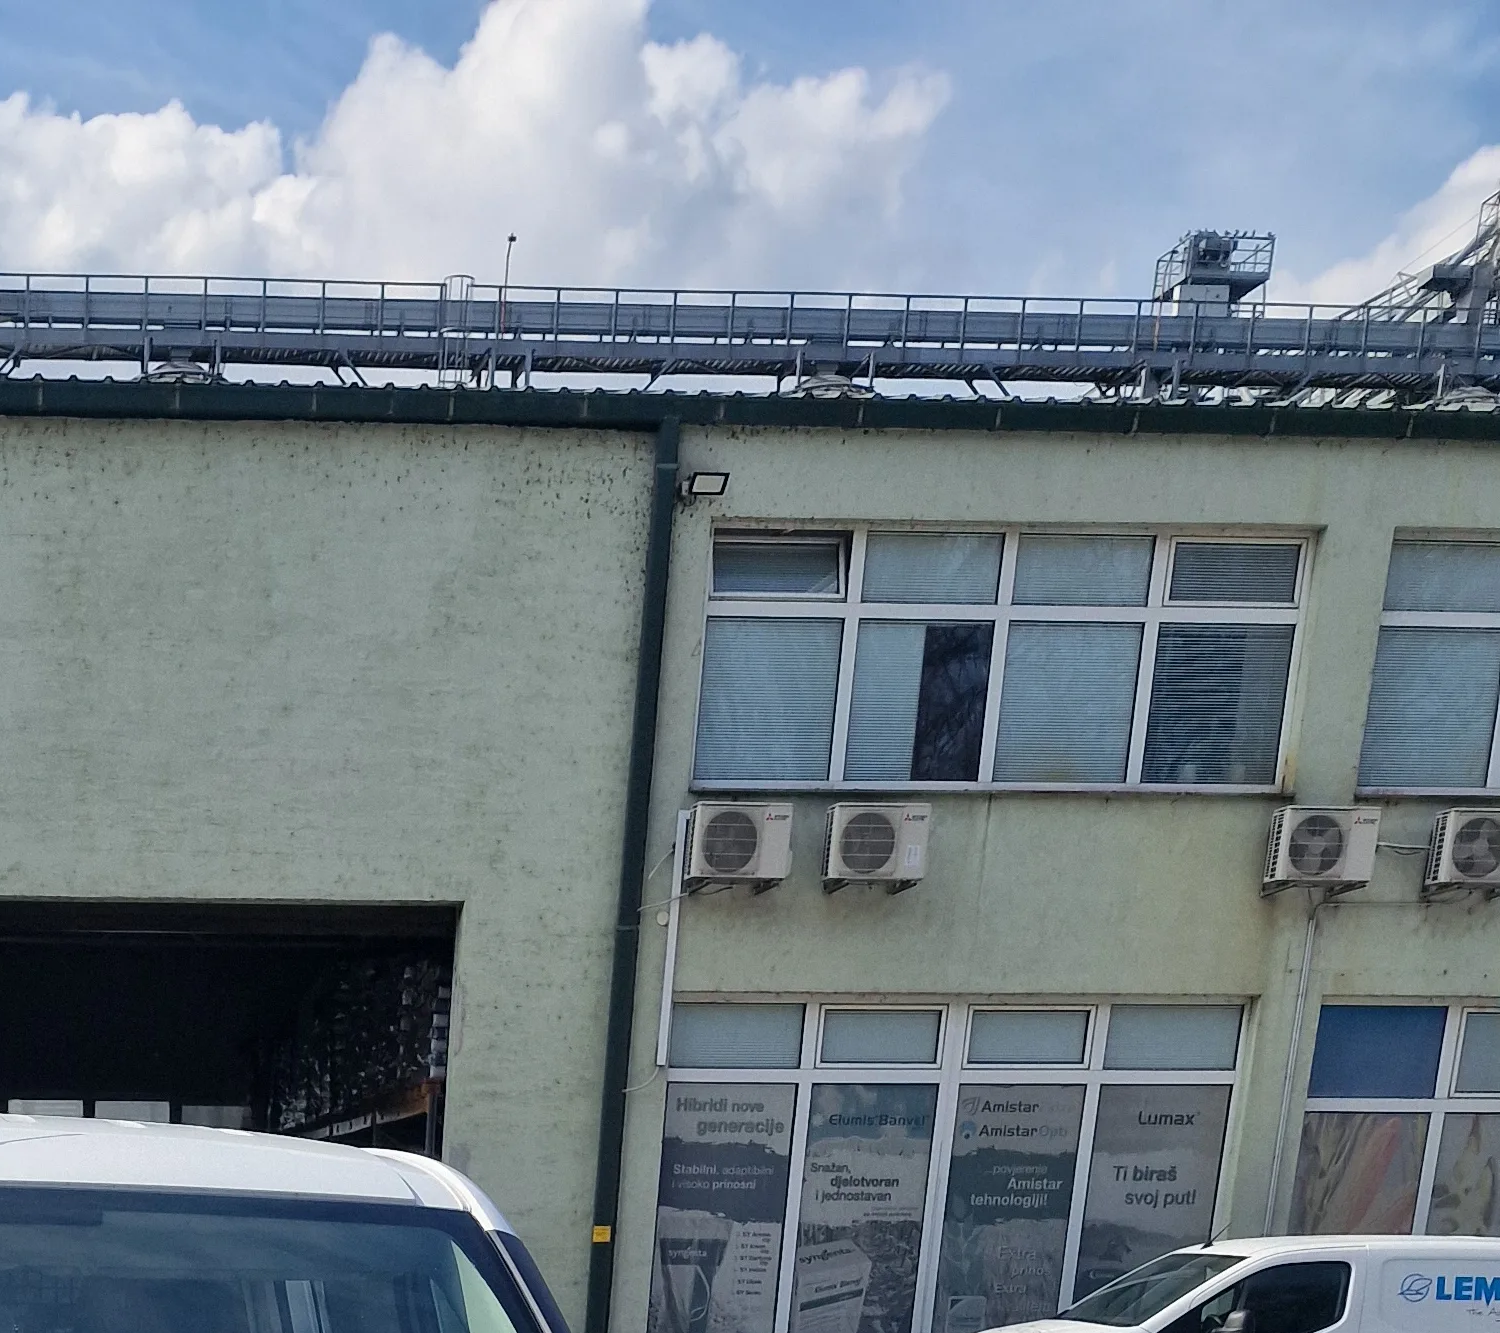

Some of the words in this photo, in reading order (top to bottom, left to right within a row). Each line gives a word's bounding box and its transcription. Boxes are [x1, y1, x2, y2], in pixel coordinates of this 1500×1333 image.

[676, 1097, 728, 1112] Hibridi
[731, 1101, 765, 1113] nove
[981, 1100, 1040, 1113] Amistar
[1138, 1110, 1195, 1125] Lumax
[696, 1118, 785, 1136] generacije
[1113, 1165, 1128, 1181] Ti
[1132, 1165, 1178, 1181] biraš
[830, 1175, 900, 1188] djelotvoran
[1007, 1177, 1063, 1190] Amistar
[970, 1193, 1048, 1208] tehnologiji!
[1124, 1189, 1159, 1208] svoj
[1163, 1189, 1197, 1208] put!
